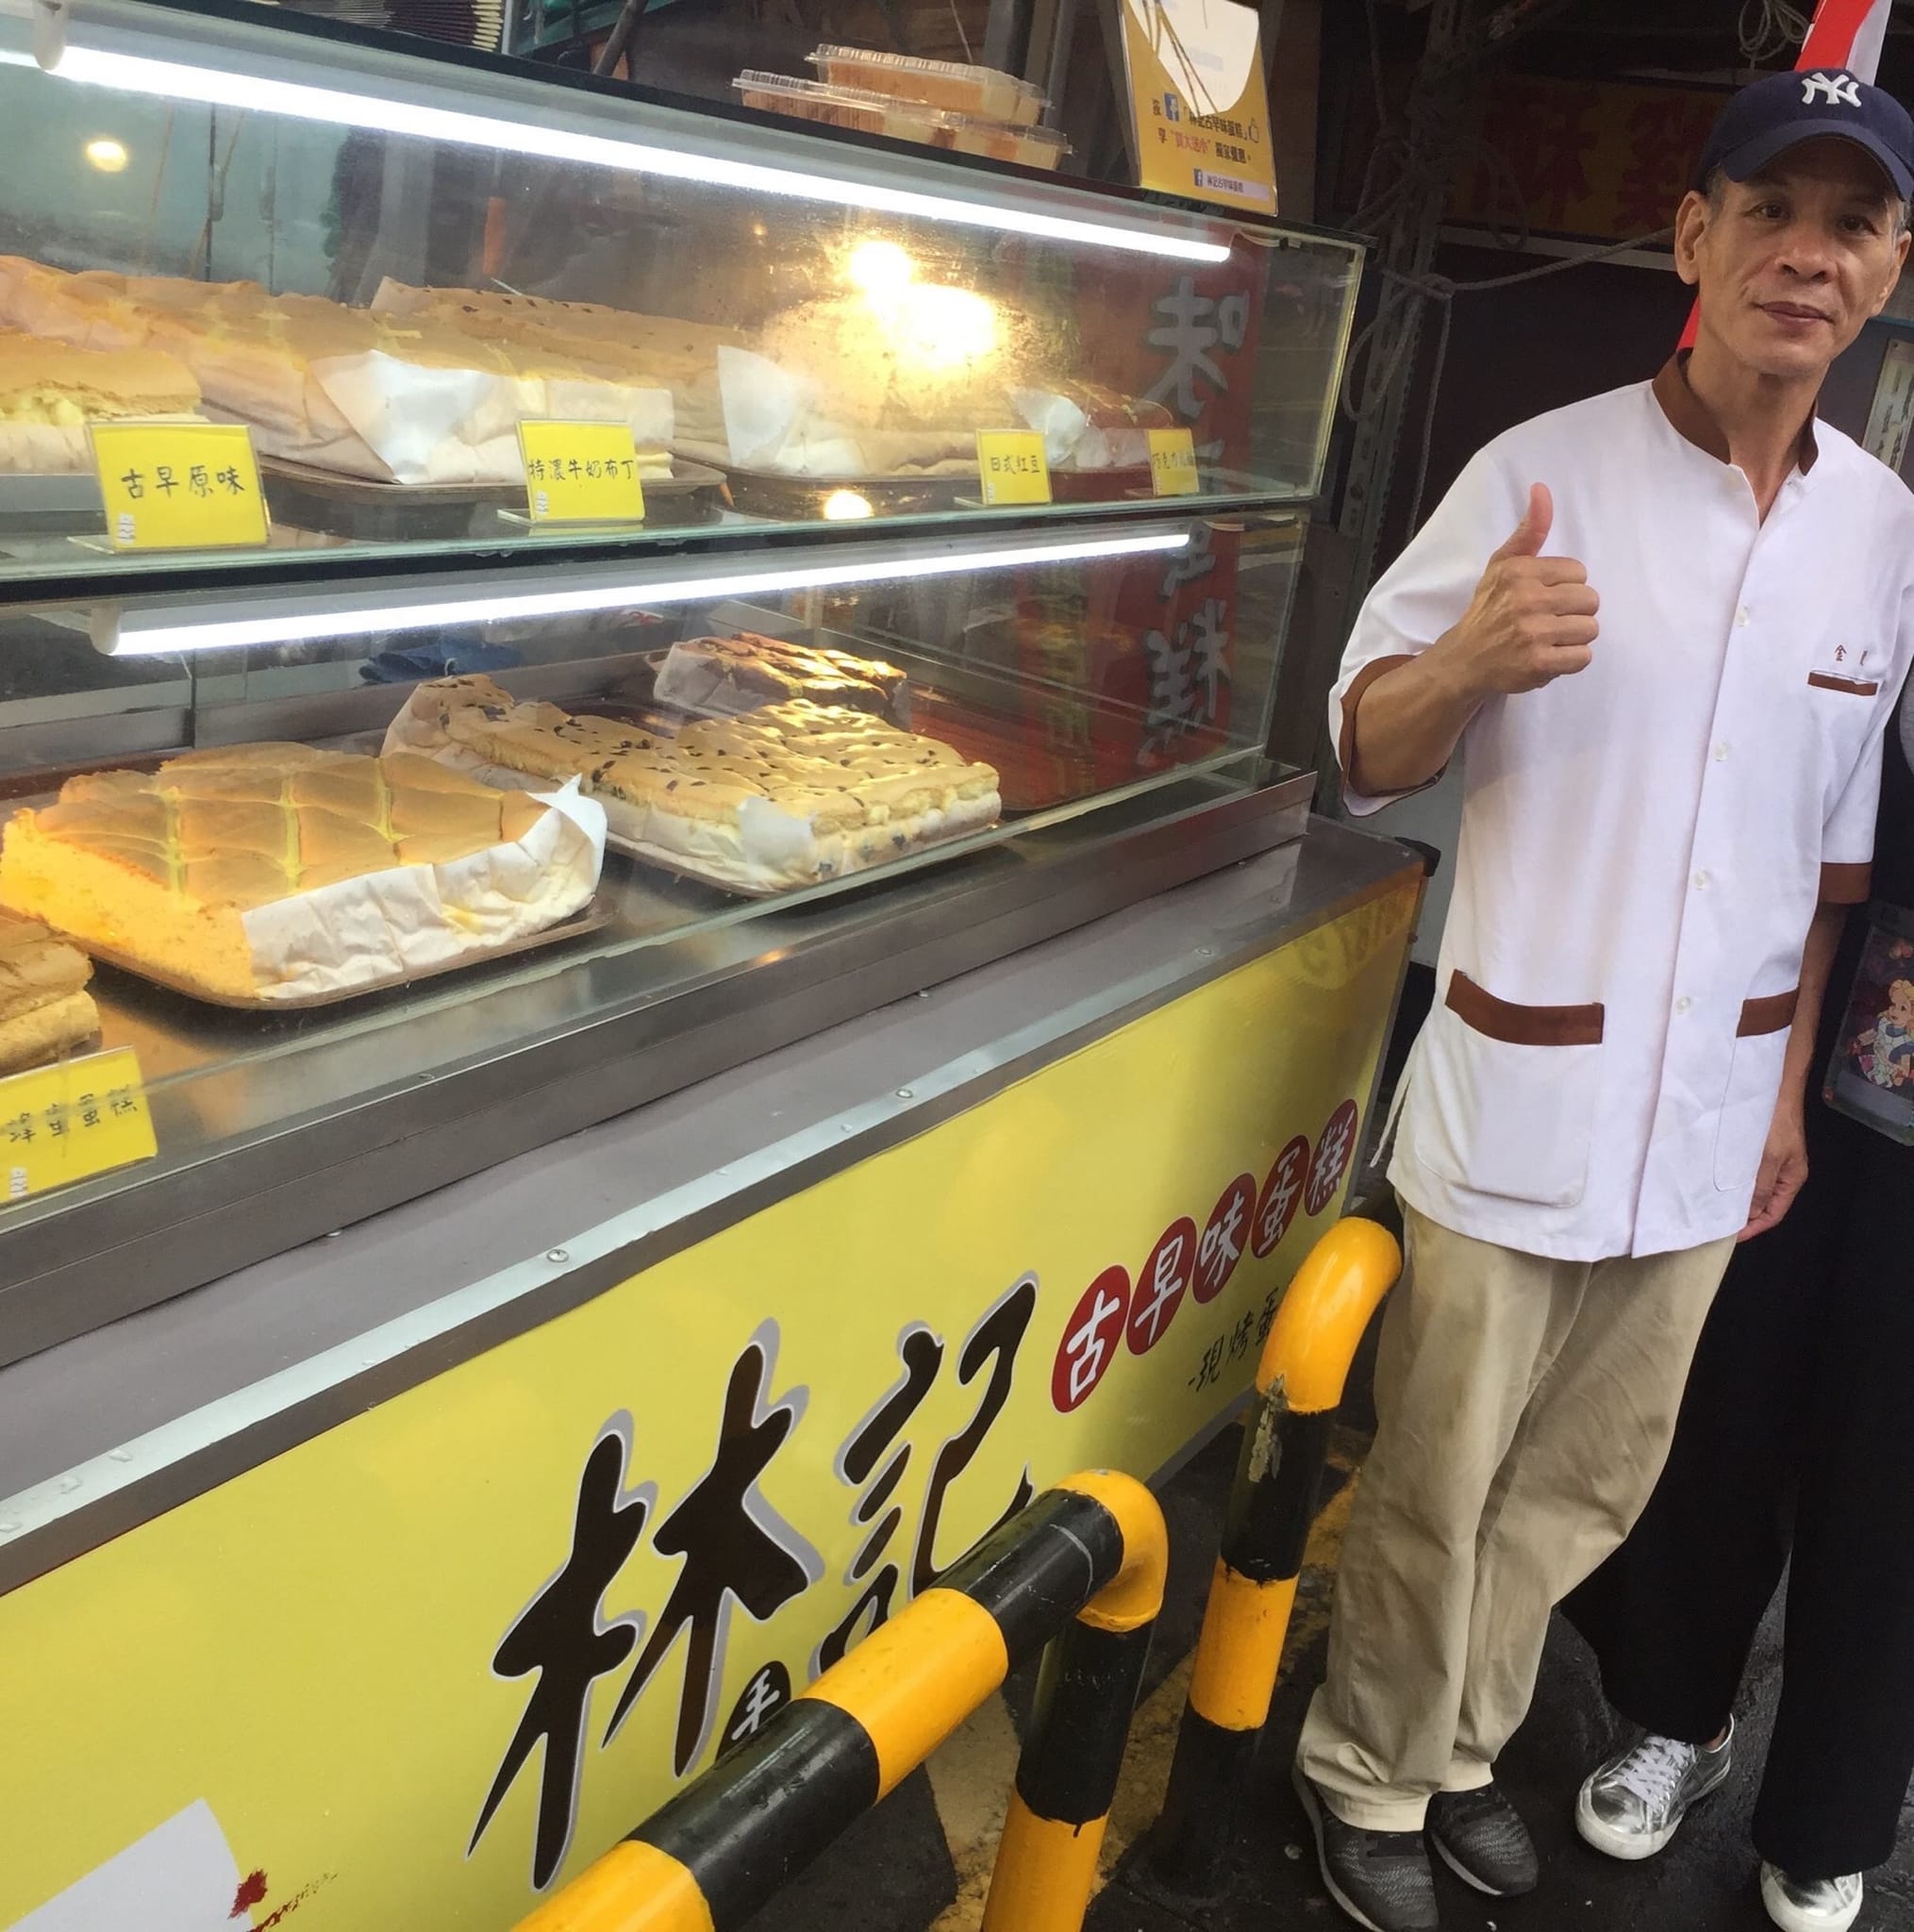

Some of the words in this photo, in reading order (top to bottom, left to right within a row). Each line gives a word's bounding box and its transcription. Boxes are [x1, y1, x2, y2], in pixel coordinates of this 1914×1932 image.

[1801, 72, 1862, 108] NY
[121, 465, 245, 499] 古早原味
[528, 458, 634, 481] 特濃牛奶布丁
[1067, 1108, 1355, 1403] 古早味蛋糕
[466, 1275, 1038, 1891] 林記
